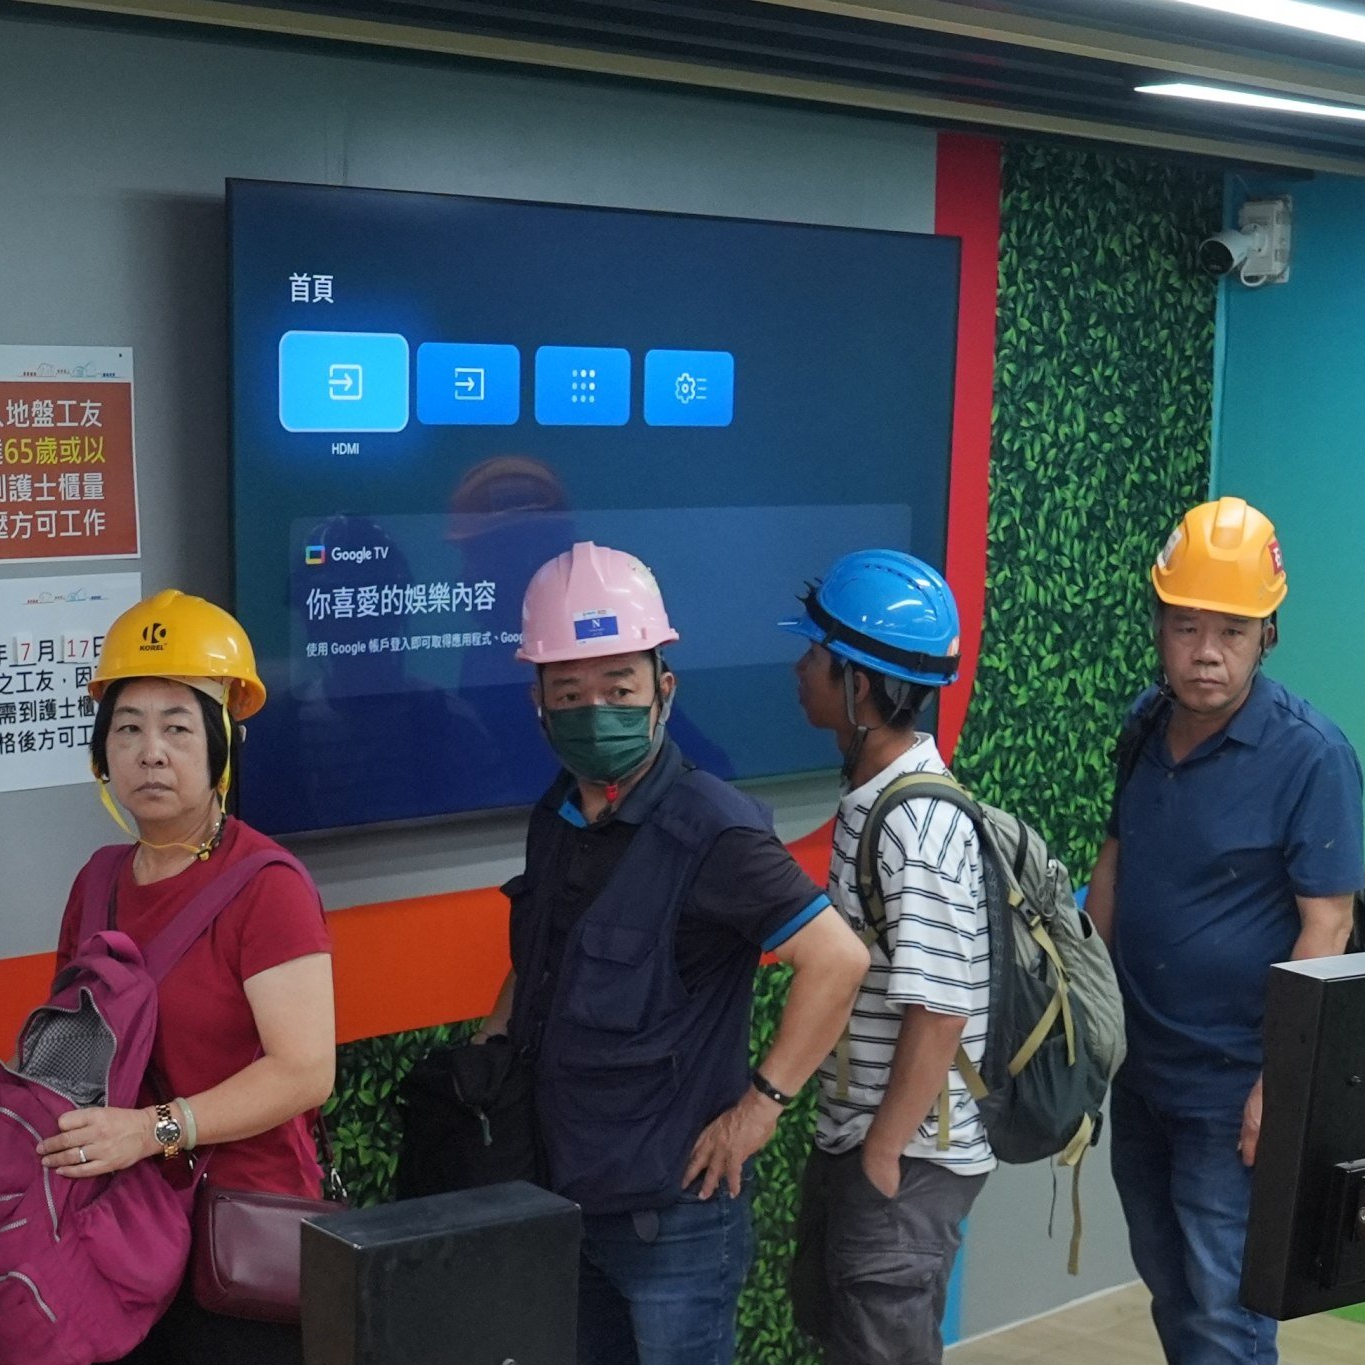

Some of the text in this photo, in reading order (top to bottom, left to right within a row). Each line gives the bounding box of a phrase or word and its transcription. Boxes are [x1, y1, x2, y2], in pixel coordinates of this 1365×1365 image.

[288, 272, 334, 303] 首頁
[331, 442, 360, 455] HDMI
[331, 546, 389, 564] Google TV
[306, 580, 496, 621] 你喜愛的娛樂內容
[306, 642, 328, 657] 使用
[330, 641, 367, 656] Google
